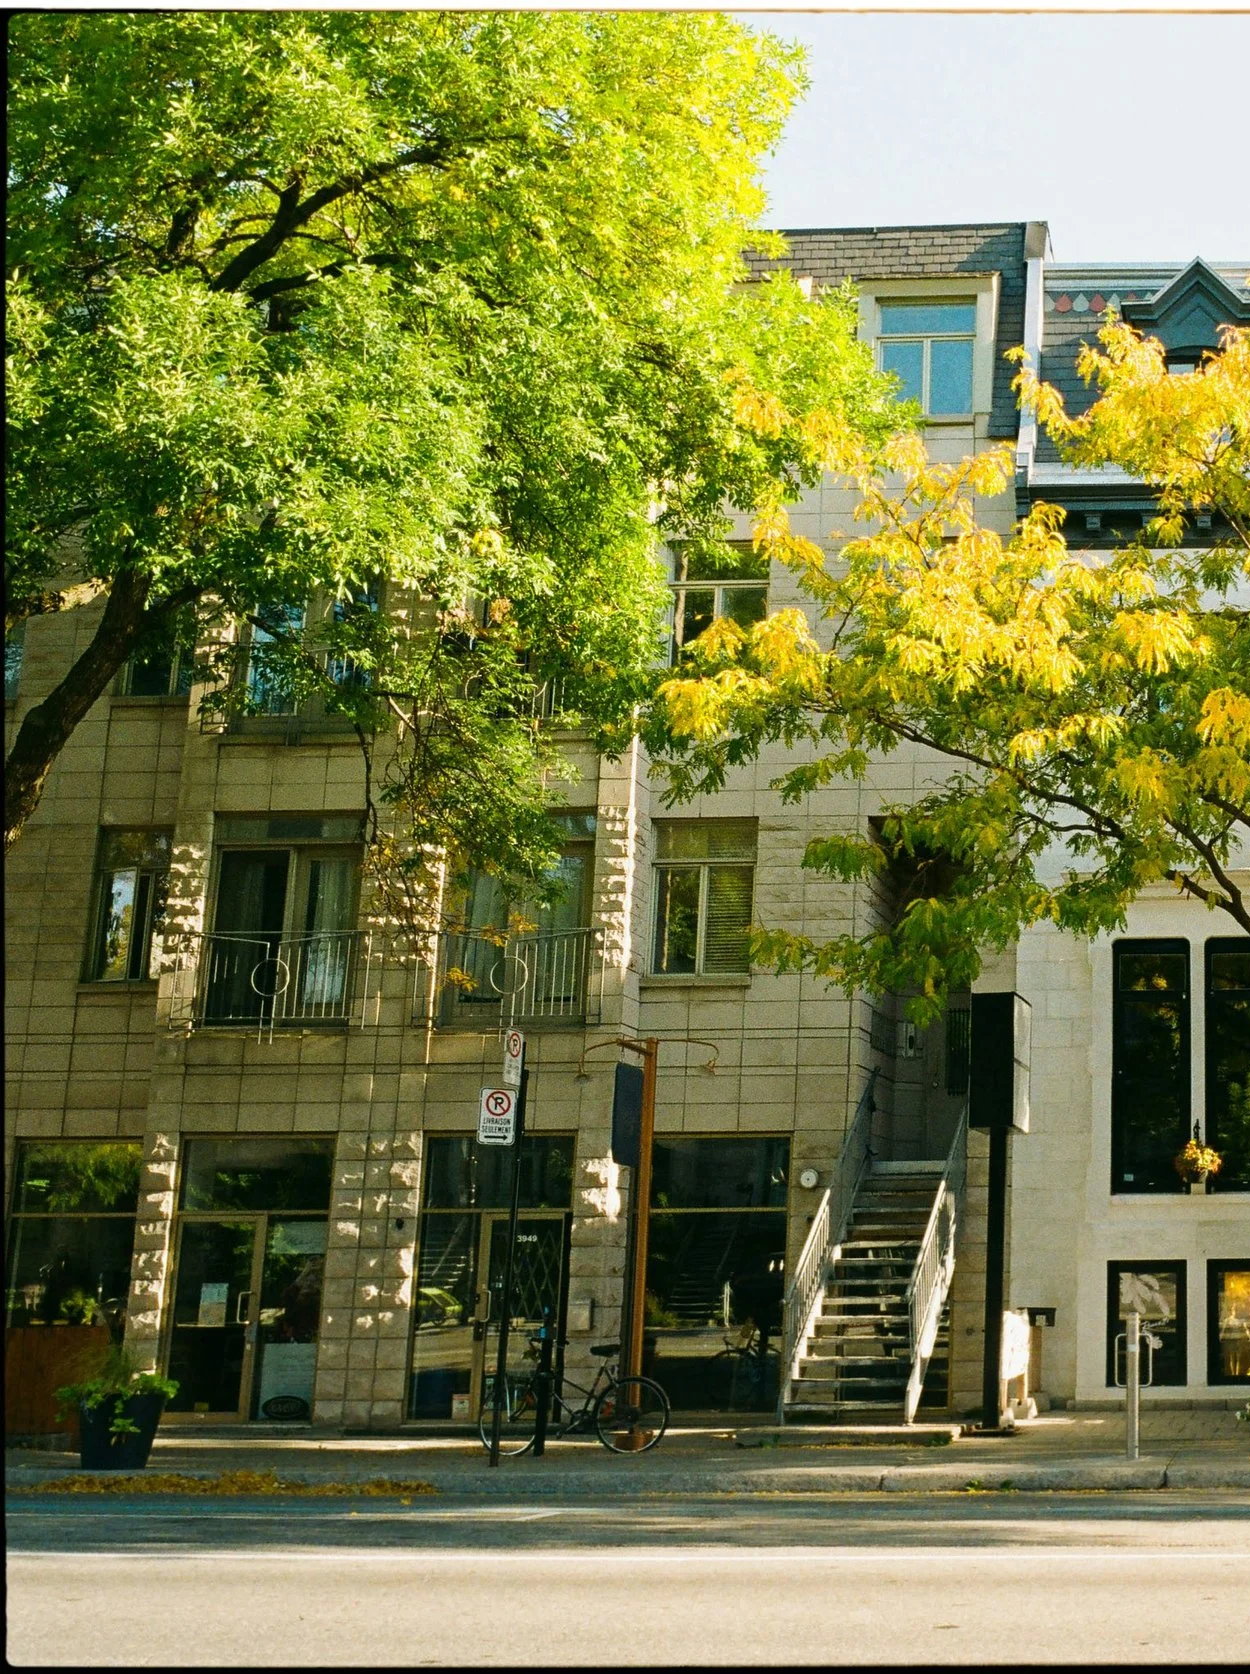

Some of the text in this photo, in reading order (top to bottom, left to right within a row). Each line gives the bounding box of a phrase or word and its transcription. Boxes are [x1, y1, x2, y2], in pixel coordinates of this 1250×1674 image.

[483, 1116, 511, 1126] LIVRAISON
[481, 1125, 512, 1134] SEULEMENT
[517, 1234, 538, 1243] 3949
